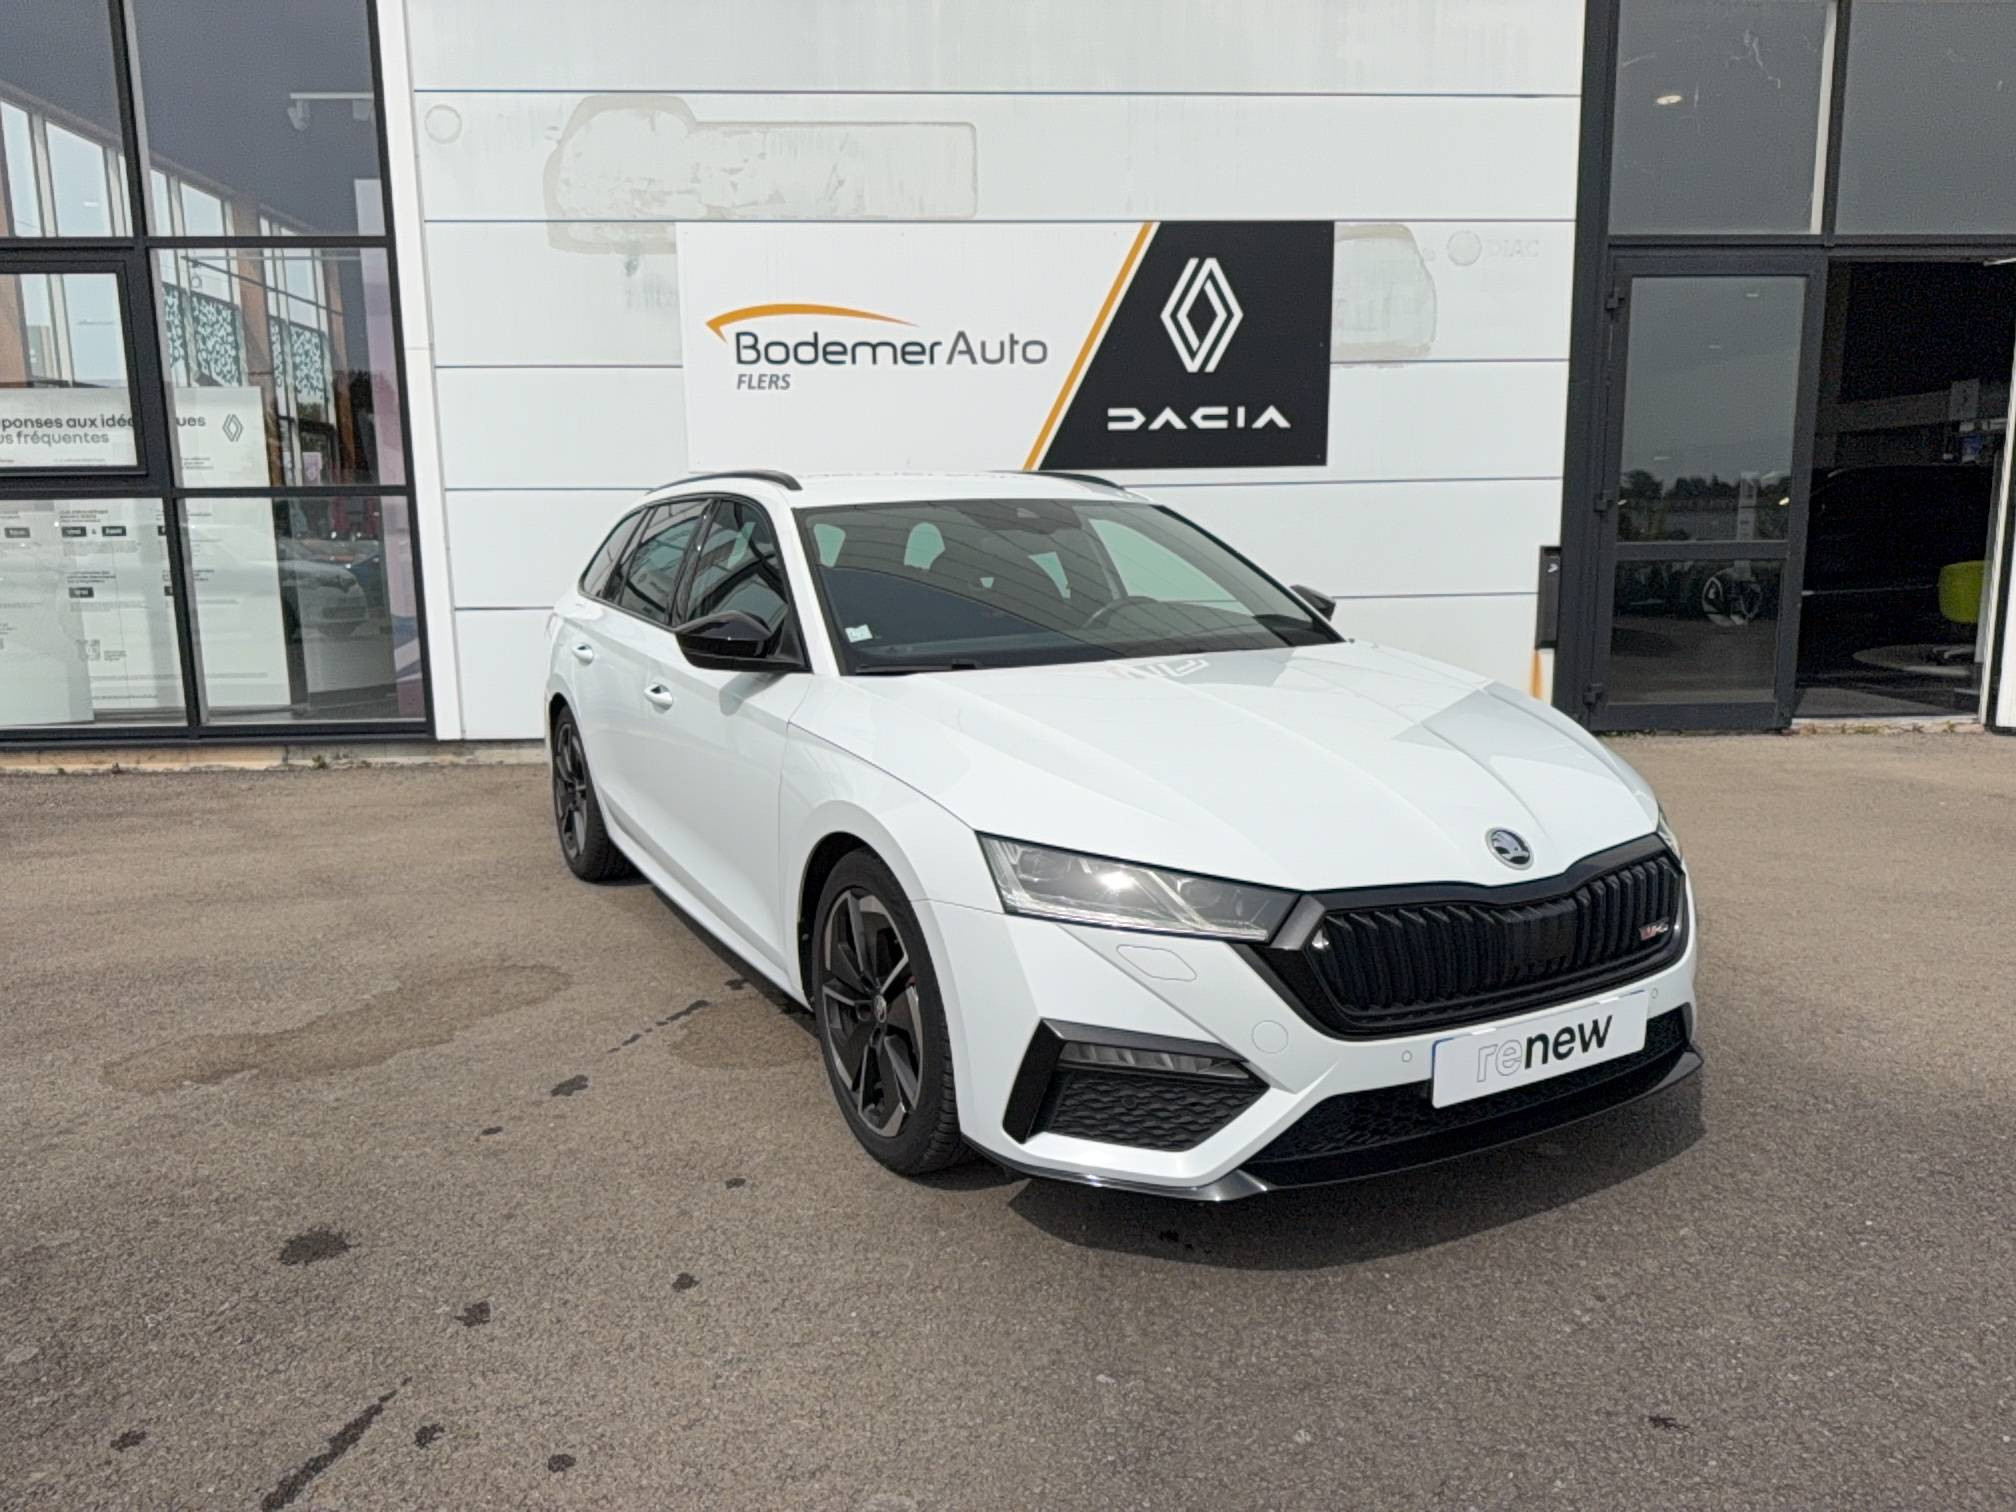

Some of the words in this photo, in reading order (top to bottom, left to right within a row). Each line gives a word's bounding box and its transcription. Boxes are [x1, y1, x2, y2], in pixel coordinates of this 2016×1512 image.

[736, 373, 792, 390] FLERS
[66, 417, 98, 428] aux
[1107, 405, 1291, 430] DACIA
[16, 430, 110, 448] fréquentes
[1476, 1014, 1614, 1084] renew
